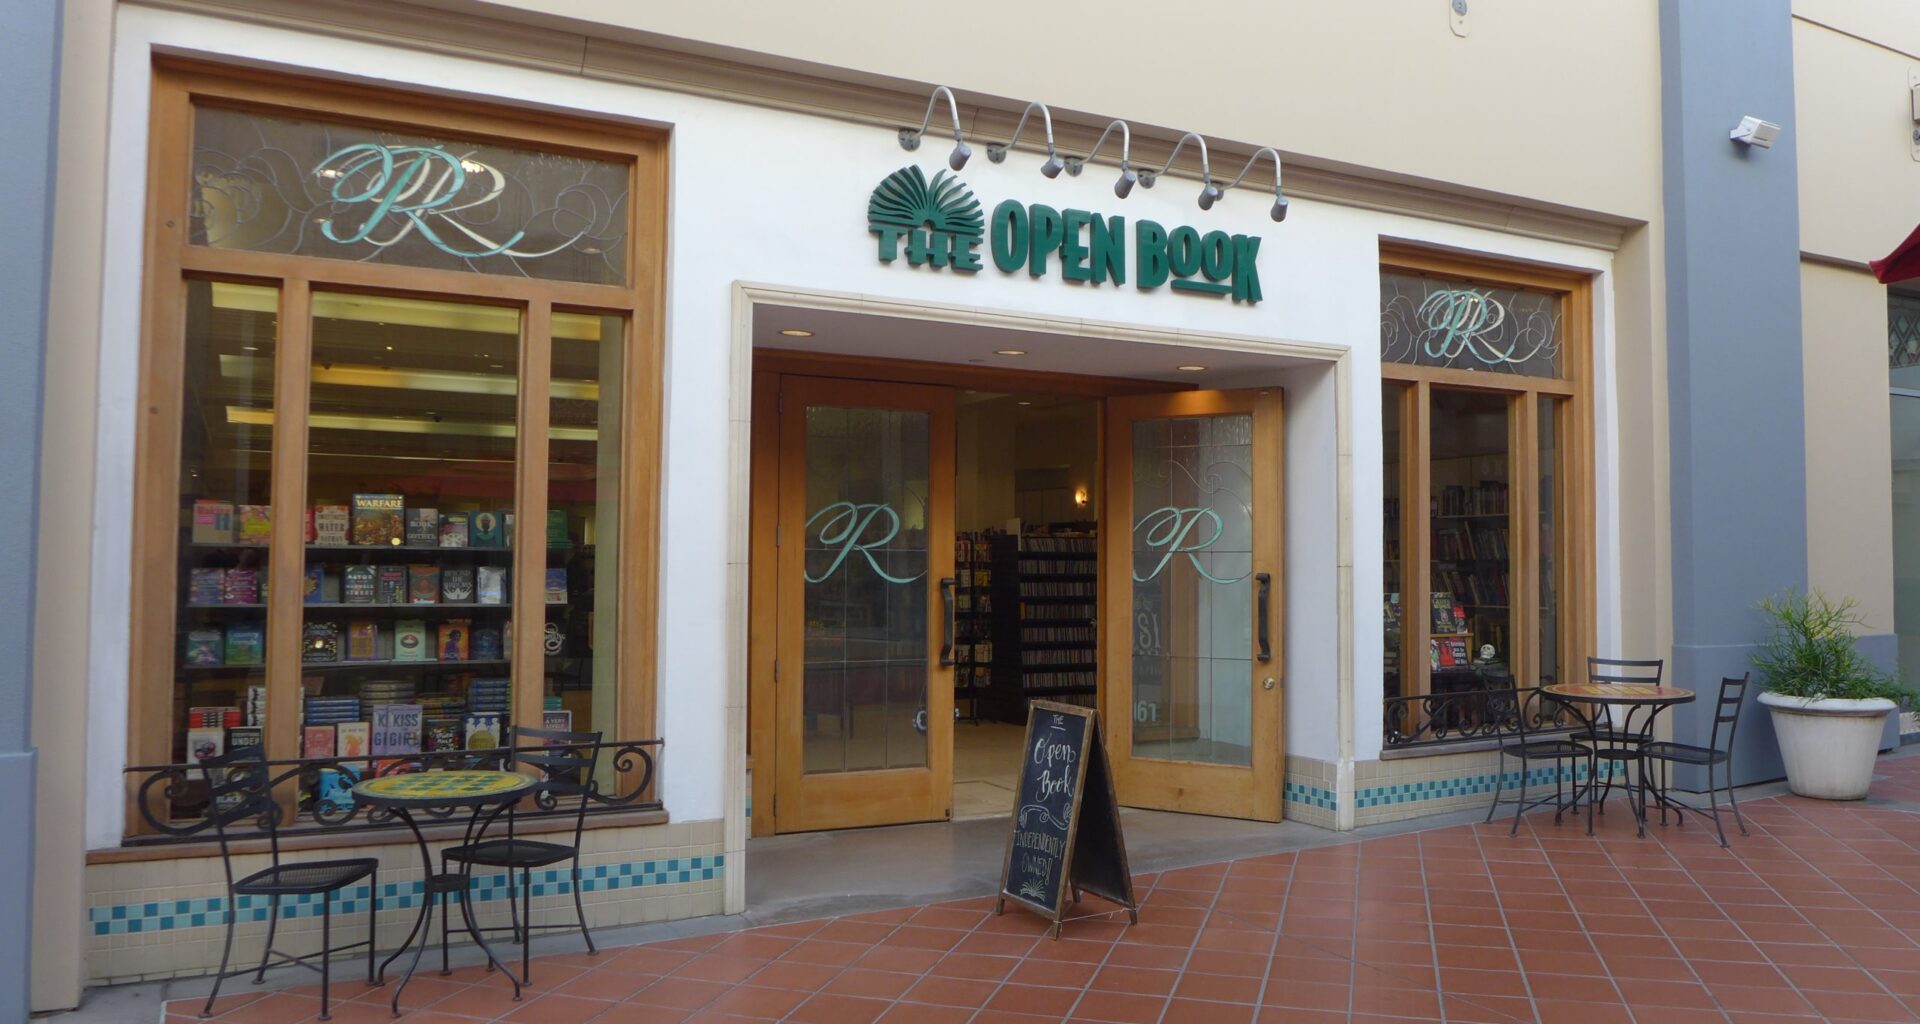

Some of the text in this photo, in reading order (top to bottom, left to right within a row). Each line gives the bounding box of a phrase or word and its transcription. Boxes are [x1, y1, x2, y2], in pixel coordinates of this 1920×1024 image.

[868, 199, 1263, 304] THE OPEN BOOK
[356, 499, 402, 508] WARFARE
[393, 711, 419, 728] KISS
[1052, 714, 1065, 725] THE
[1034, 735, 1076, 768] Open
[1036, 764, 1075, 803] Book
